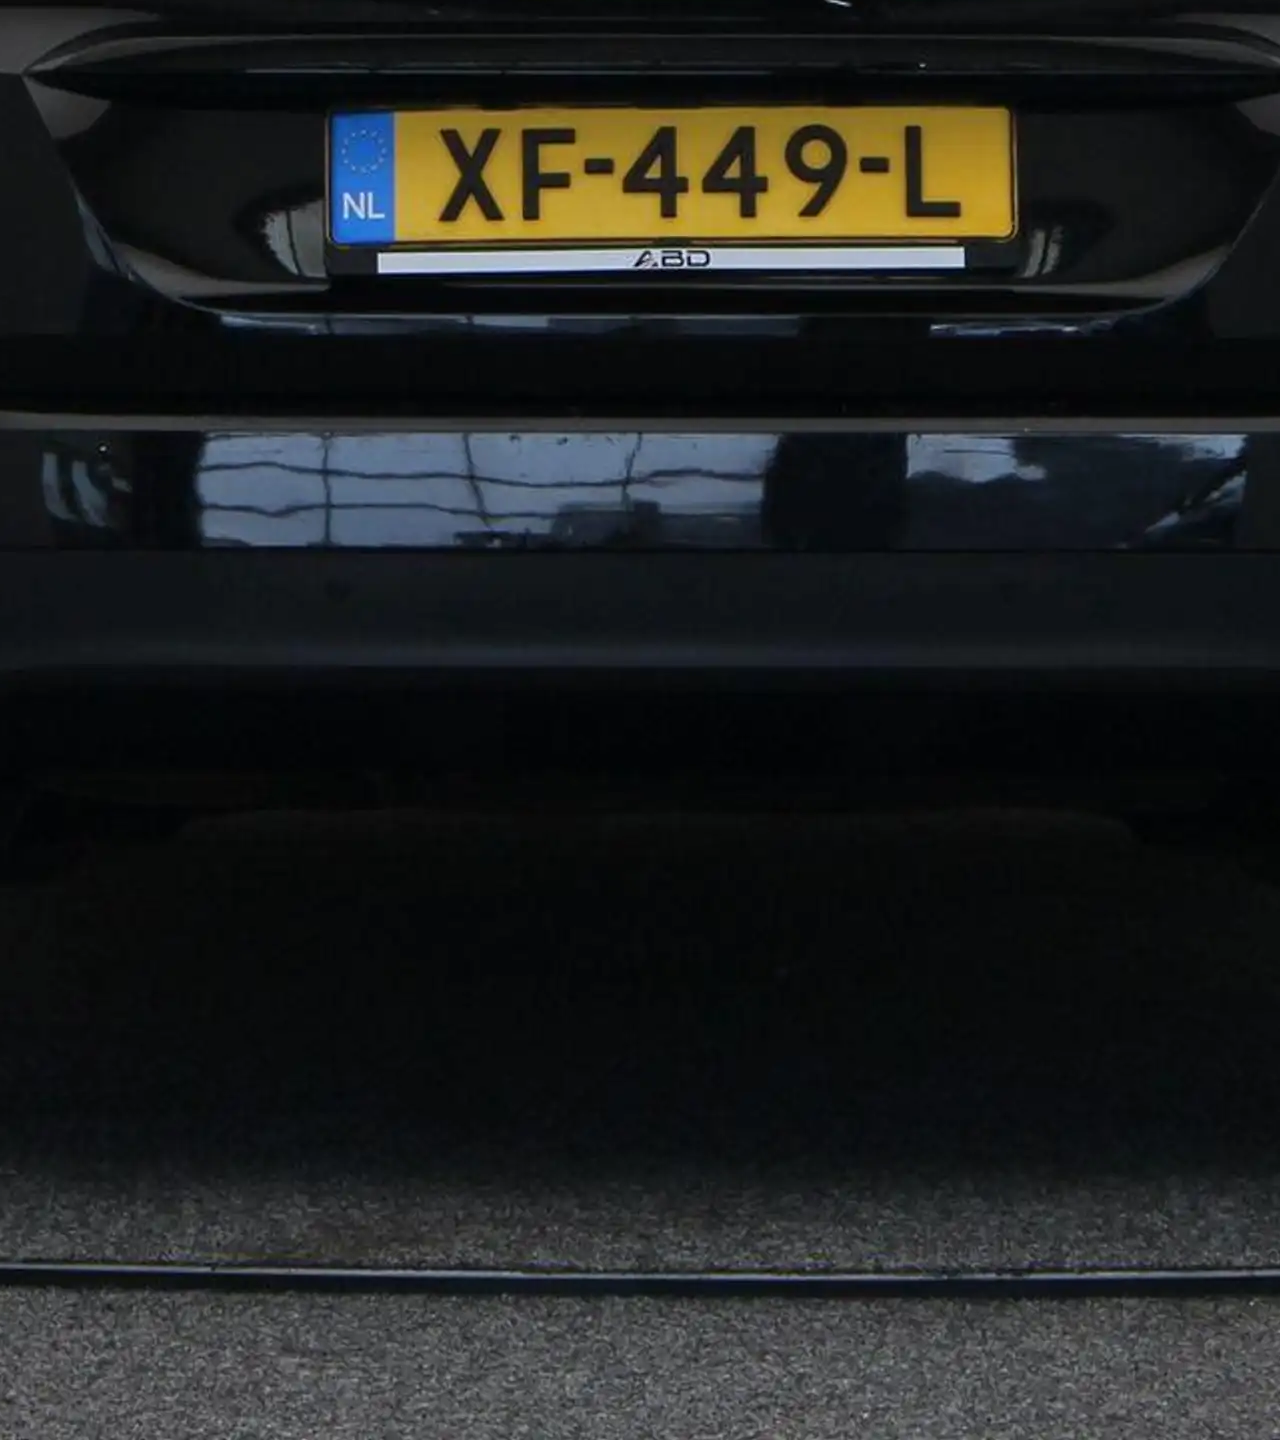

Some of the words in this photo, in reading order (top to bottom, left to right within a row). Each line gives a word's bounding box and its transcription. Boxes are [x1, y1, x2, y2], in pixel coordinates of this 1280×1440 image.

[438, 124, 961, 222] XF-449-L
[343, 192, 385, 220] NL
[633, 250, 710, 267] ABD
